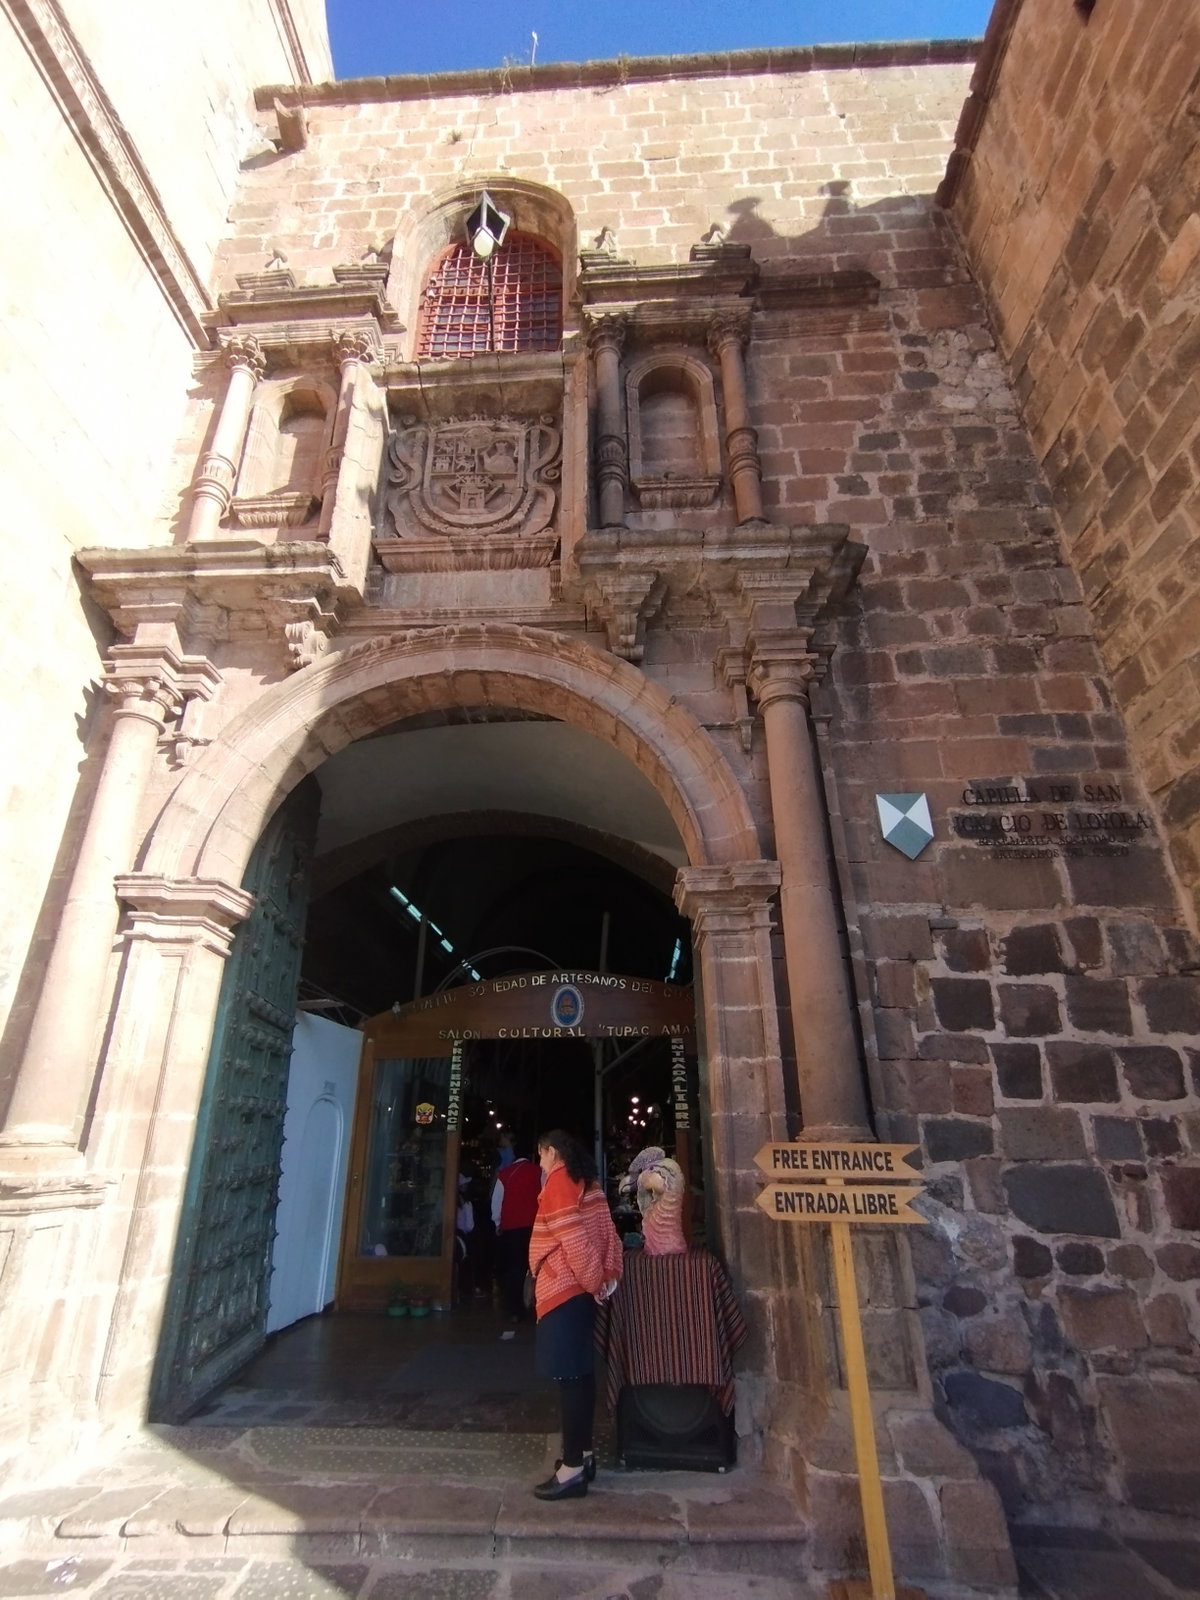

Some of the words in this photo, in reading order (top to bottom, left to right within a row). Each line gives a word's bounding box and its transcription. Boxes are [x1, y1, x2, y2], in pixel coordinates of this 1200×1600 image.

[962, 786, 1041, 806] CAPILLA
[1049, 785, 1074, 802] DE
[1083, 784, 1123, 802] SAN
[954, 813, 1032, 833] IGNACIO
[1042, 813, 1069, 831] DE
[1075, 811, 1149, 831] LOYOLA
[531, 974, 547, 986] DE
[551, 973, 627, 990] ARTESANOS
[631, 981, 655, 994] DEL
[438, 1029, 482, 1040] SALON
[498, 1026, 586, 1038] CULTURAL
[660, 1023, 695, 1037] AMA
[772, 1149, 809, 1169] FREE
[812, 1149, 894, 1172] ENTRANCE
[774, 1191, 850, 1215] ENTRADA
[852, 1193, 899, 1216] LIBRE
